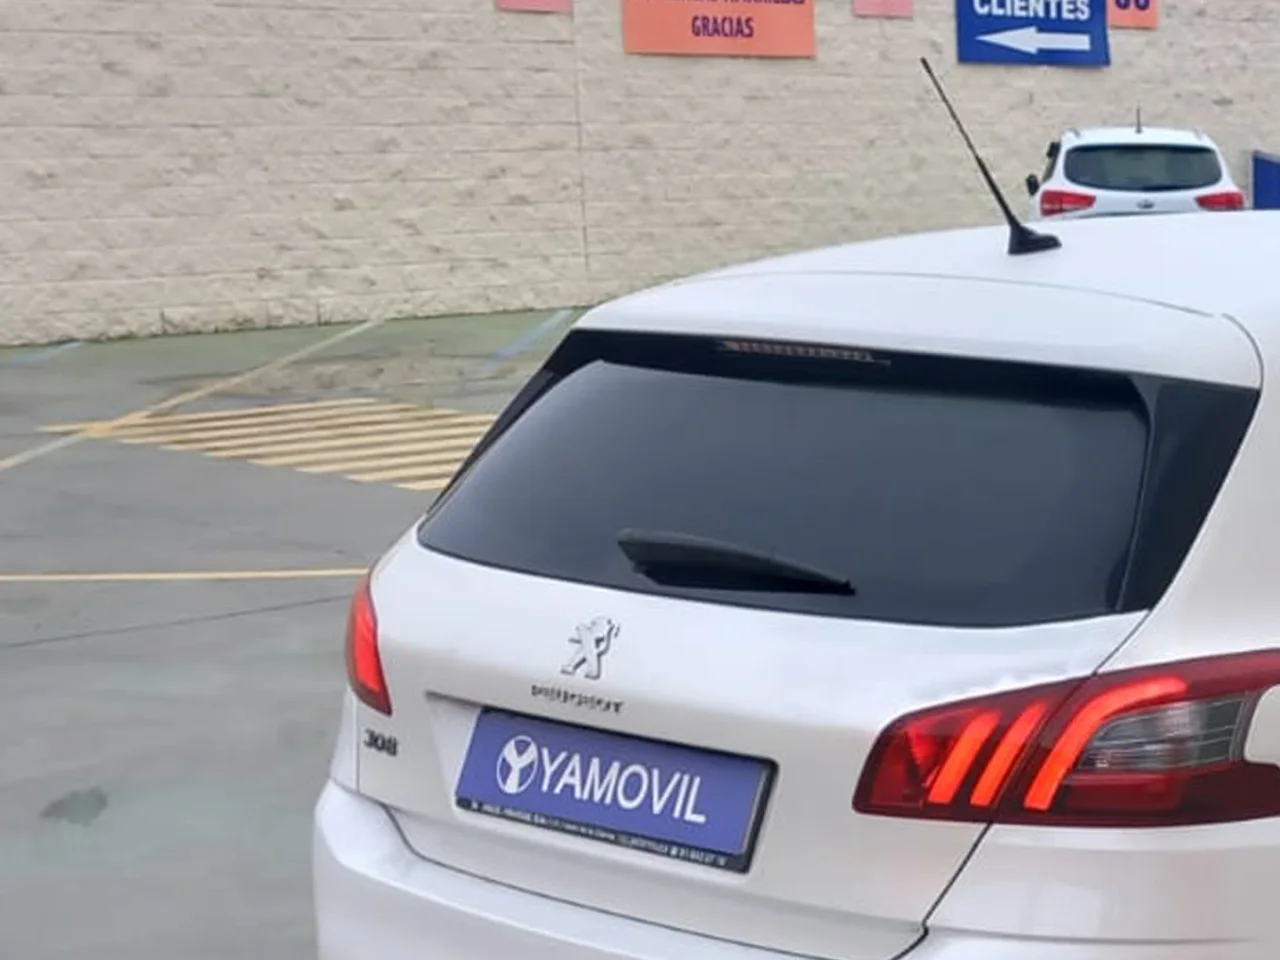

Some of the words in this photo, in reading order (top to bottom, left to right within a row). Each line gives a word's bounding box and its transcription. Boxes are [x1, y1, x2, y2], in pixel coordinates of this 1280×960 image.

[973, 0, 1091, 20] CLIENTES
[691, 15, 754, 38] GRACIAS
[363, 729, 398, 756] 308
[539, 746, 707, 824] YAMOVIL
